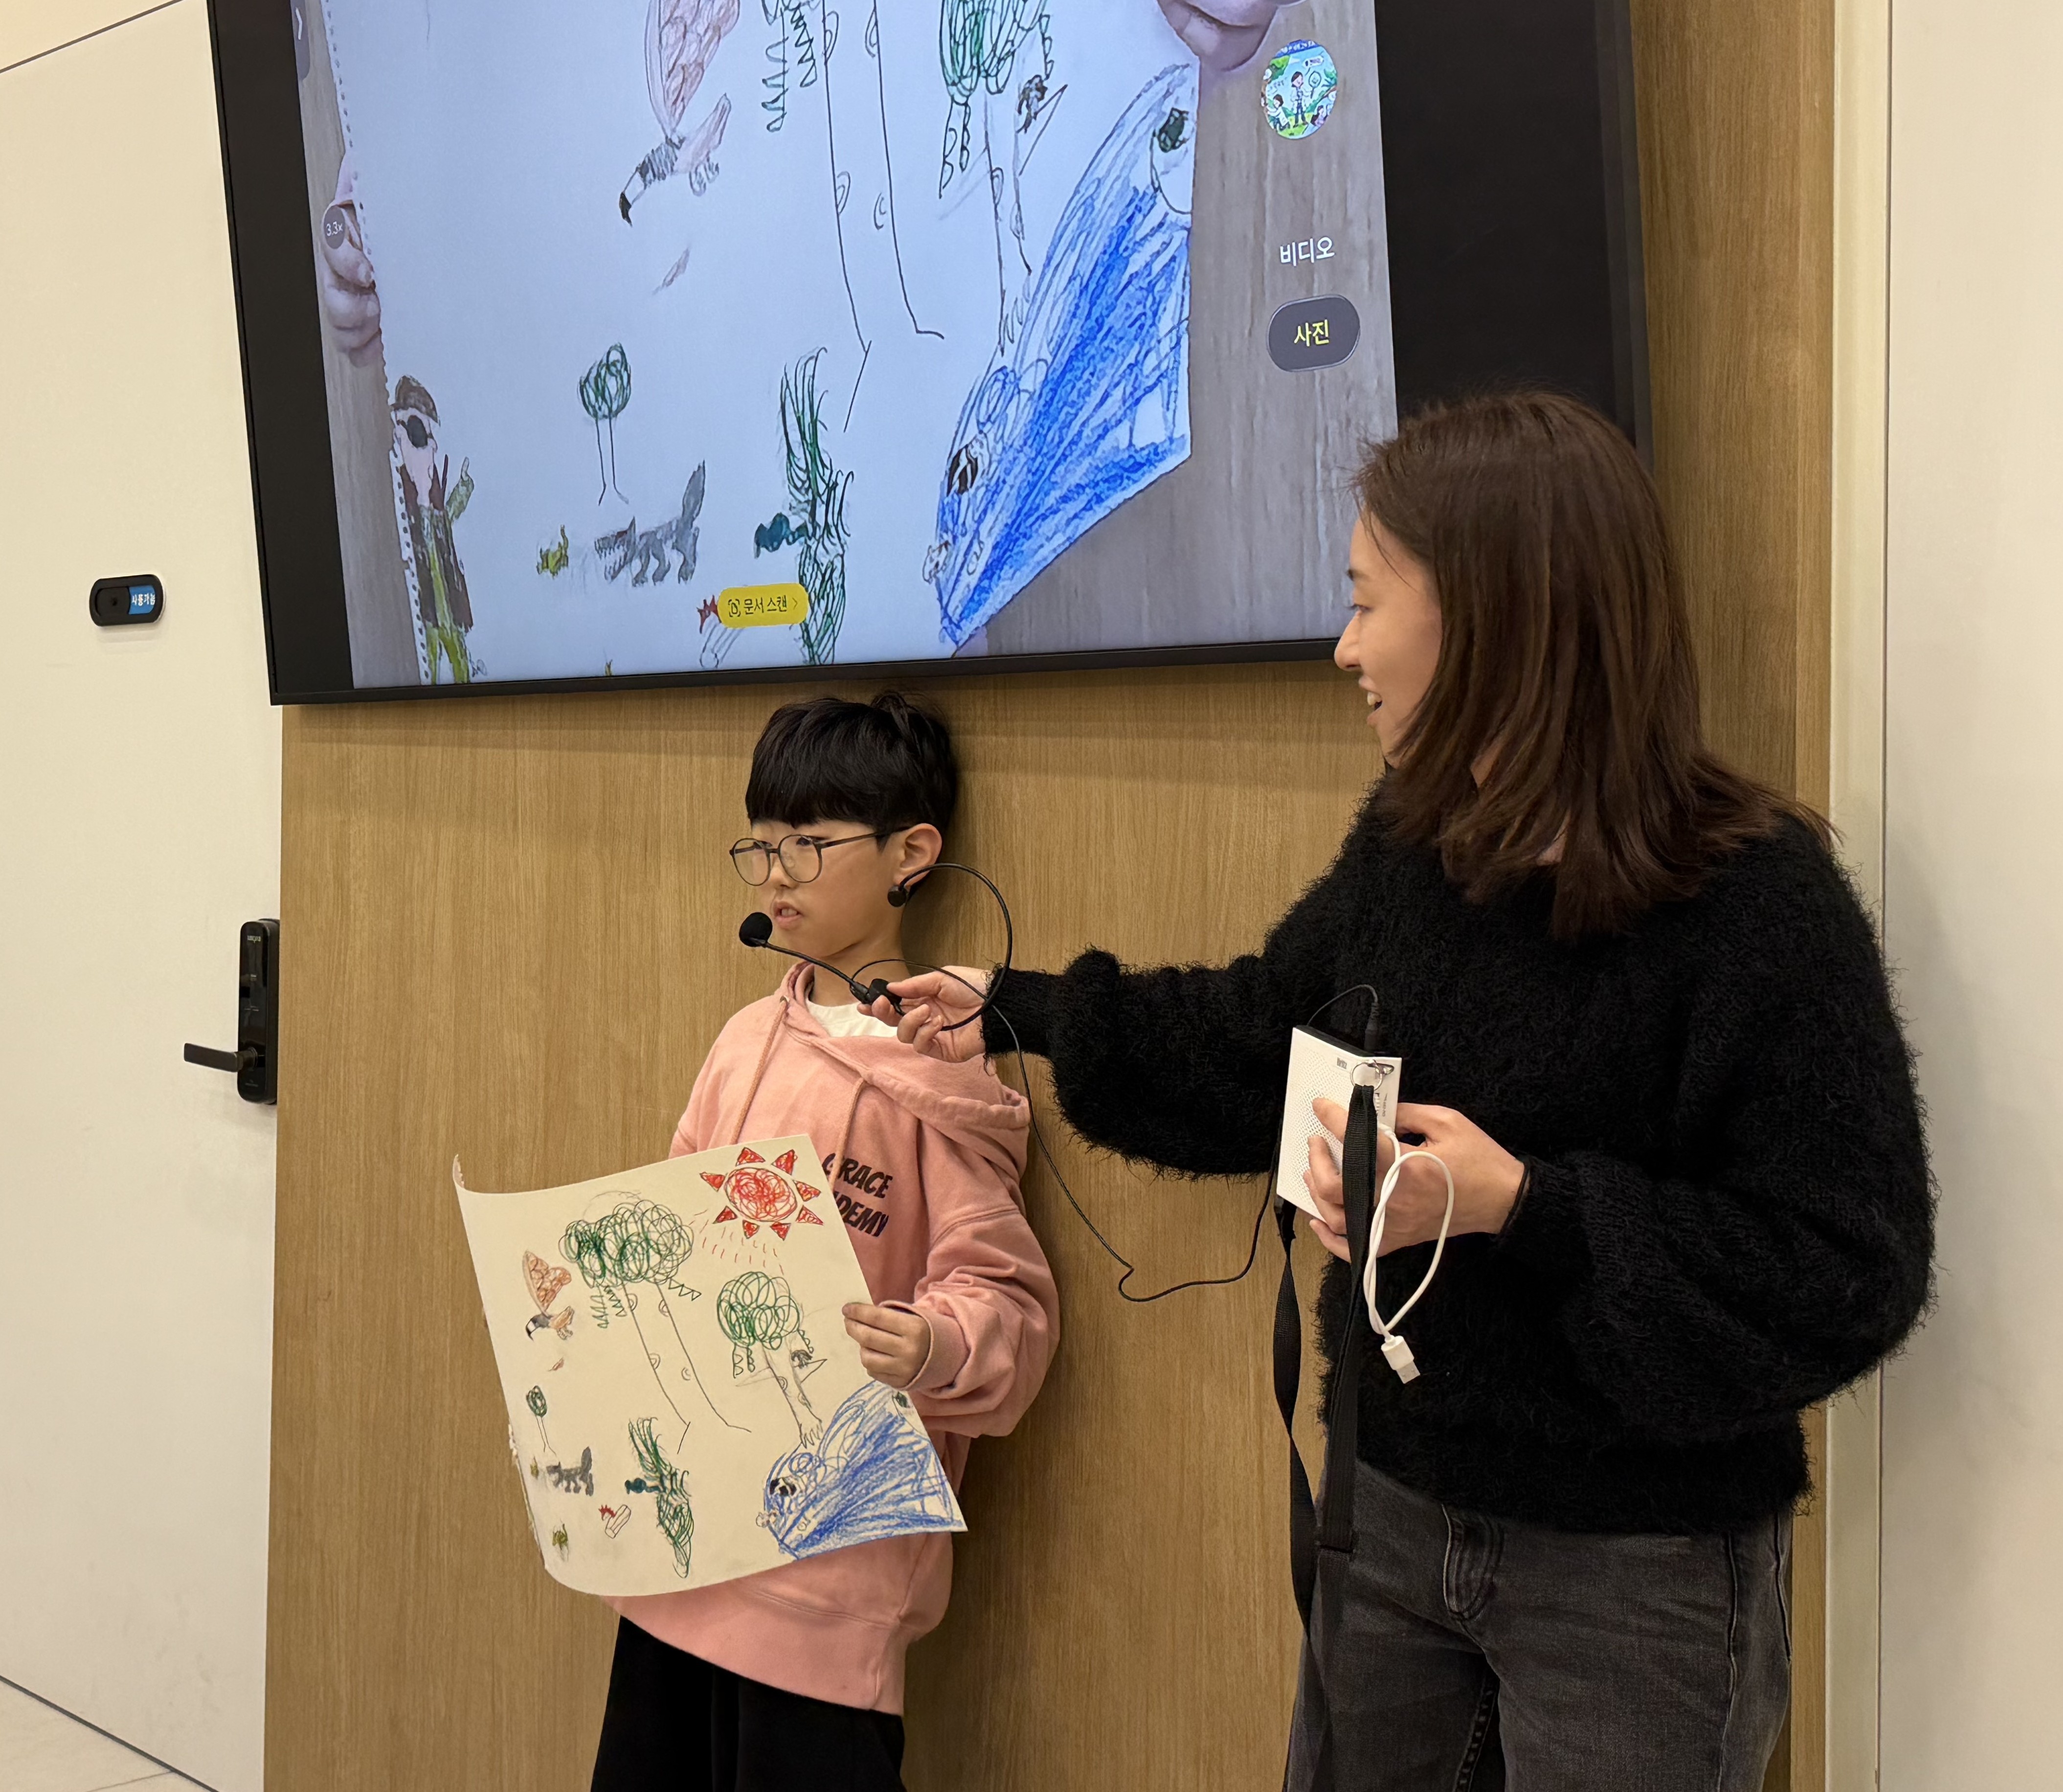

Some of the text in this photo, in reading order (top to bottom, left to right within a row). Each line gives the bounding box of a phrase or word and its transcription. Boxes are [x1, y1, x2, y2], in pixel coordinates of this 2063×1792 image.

[326, 221, 343, 236] 3.3x
[1280, 236, 1335, 266] 비디오
[1294, 319, 1330, 346] 사진
[743, 595, 787, 615] 문서 스캔
[833, 1191, 889, 1237] DEMY
